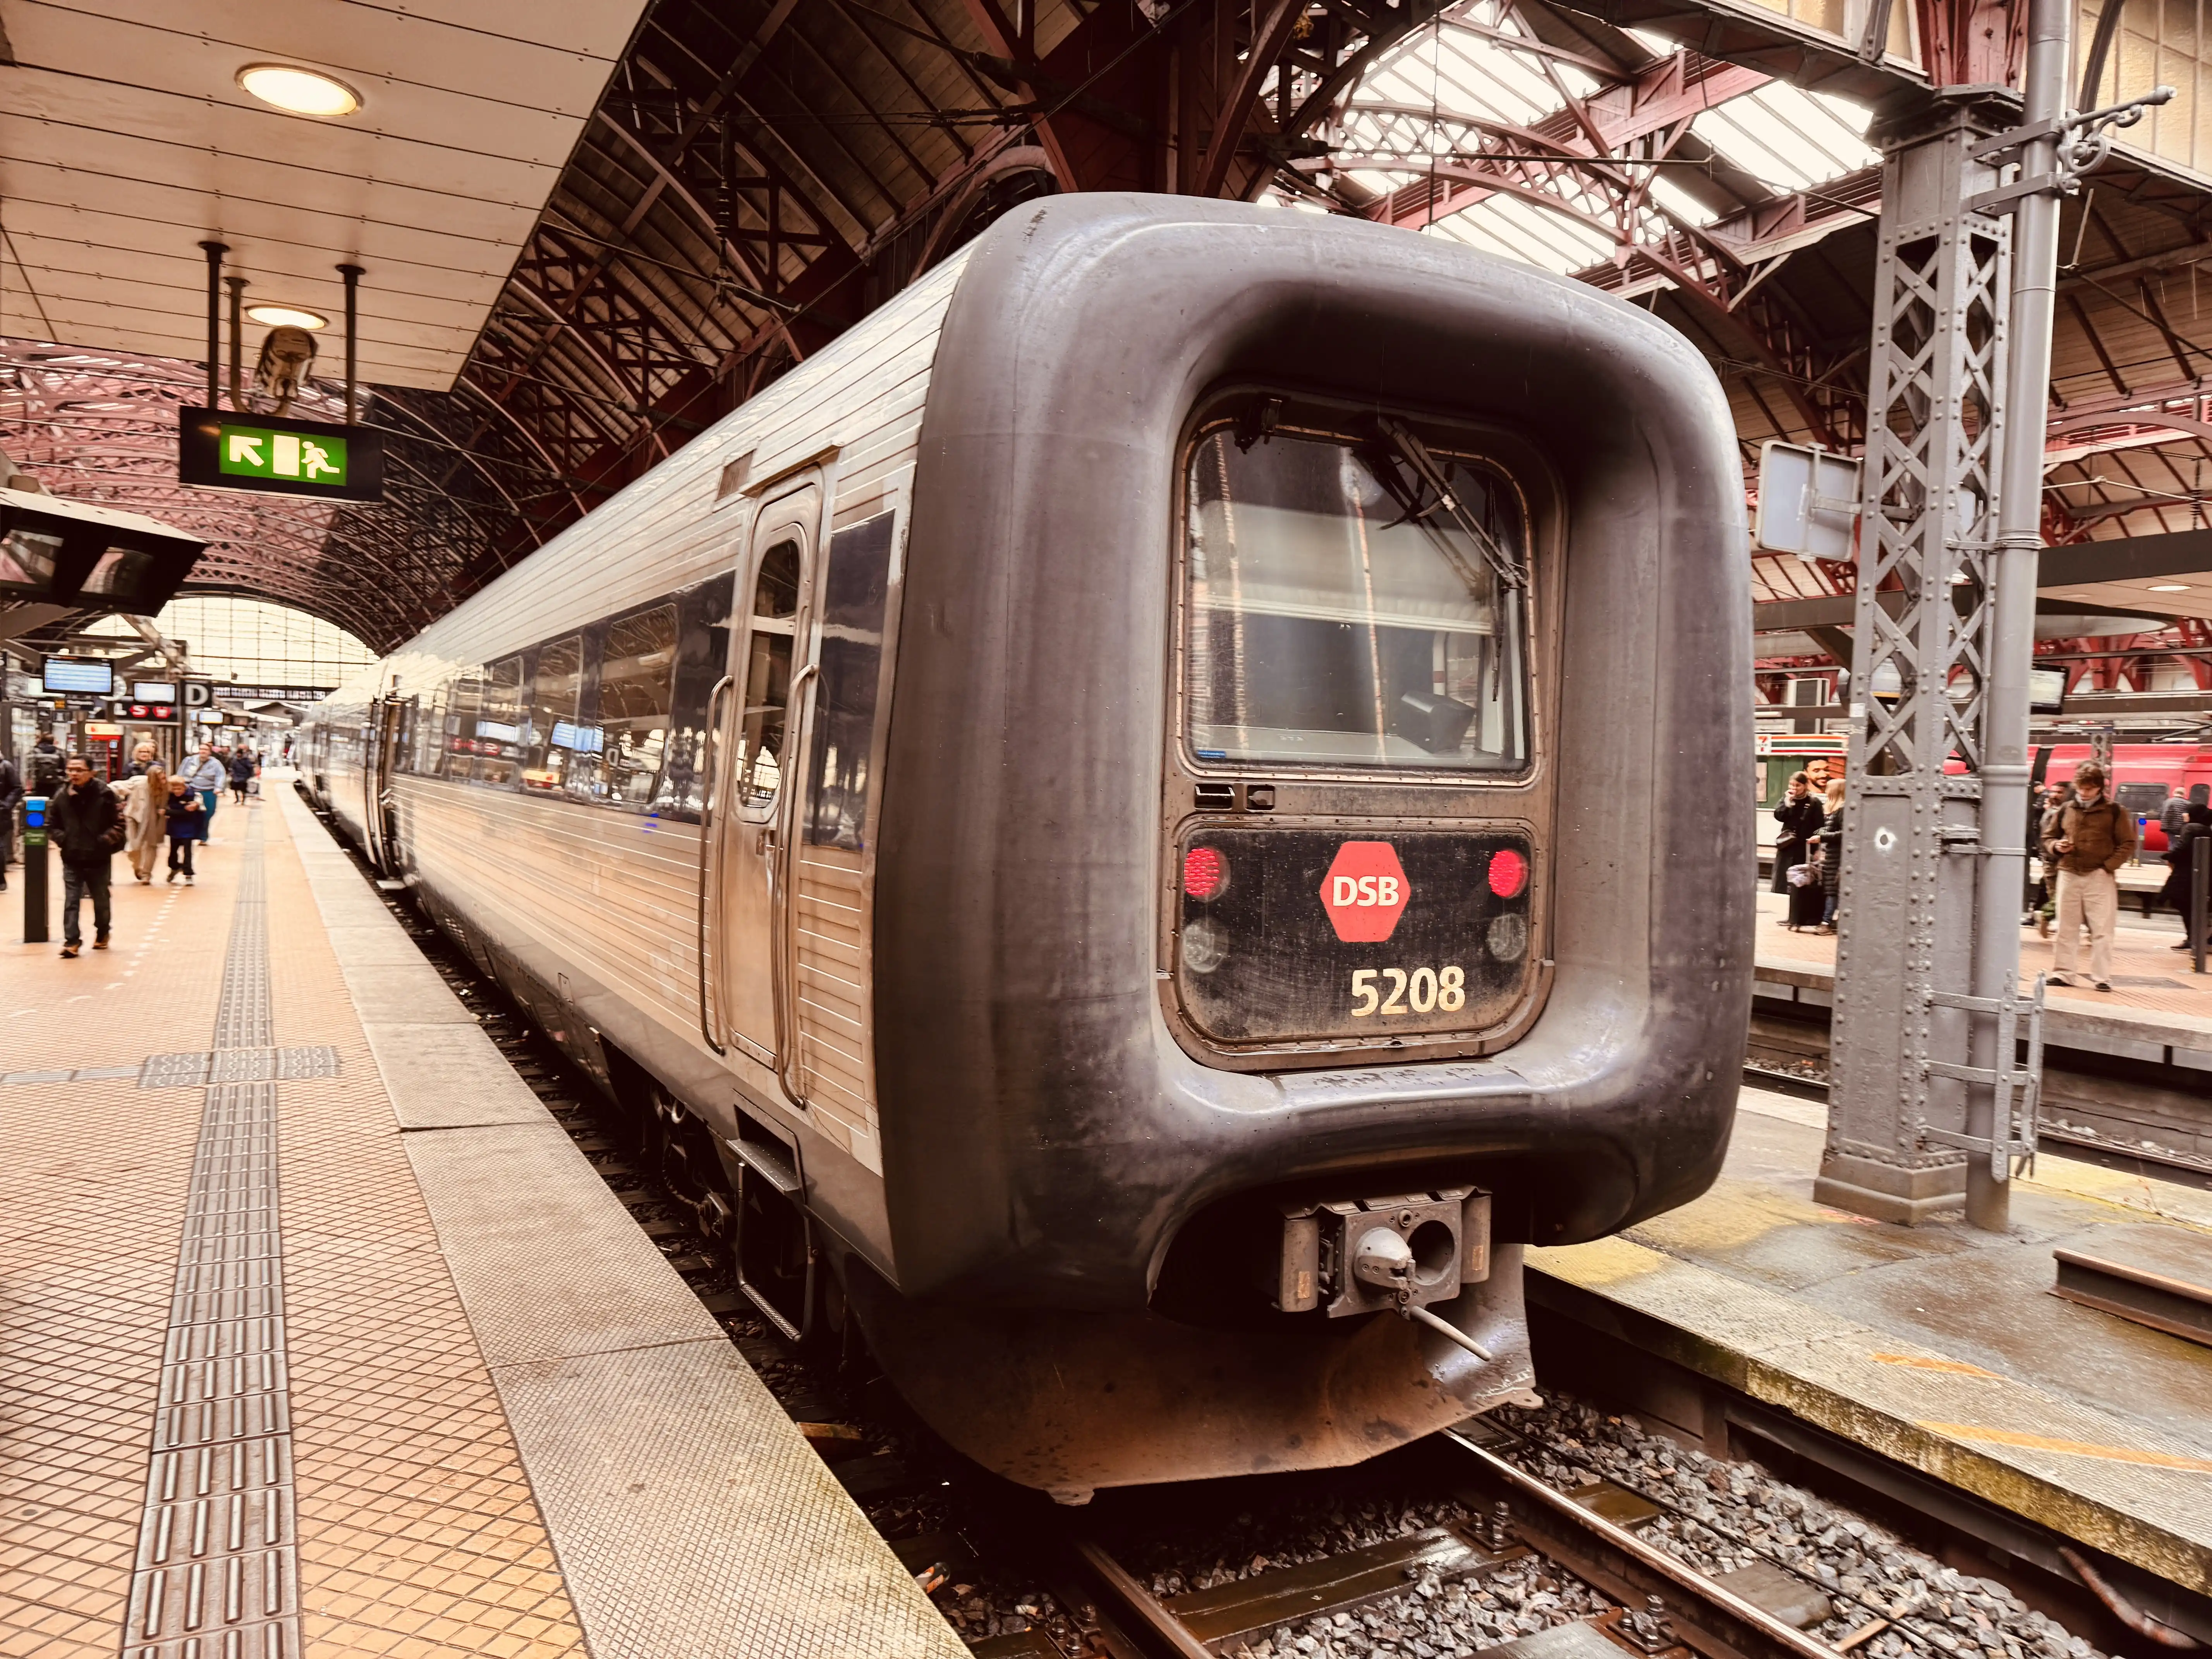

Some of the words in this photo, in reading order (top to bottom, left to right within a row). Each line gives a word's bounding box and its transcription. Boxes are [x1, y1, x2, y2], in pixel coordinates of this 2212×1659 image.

[185, 684, 208, 705] D
[1333, 876, 1399, 907] DSB
[1351, 966, 1465, 1017] 5208
